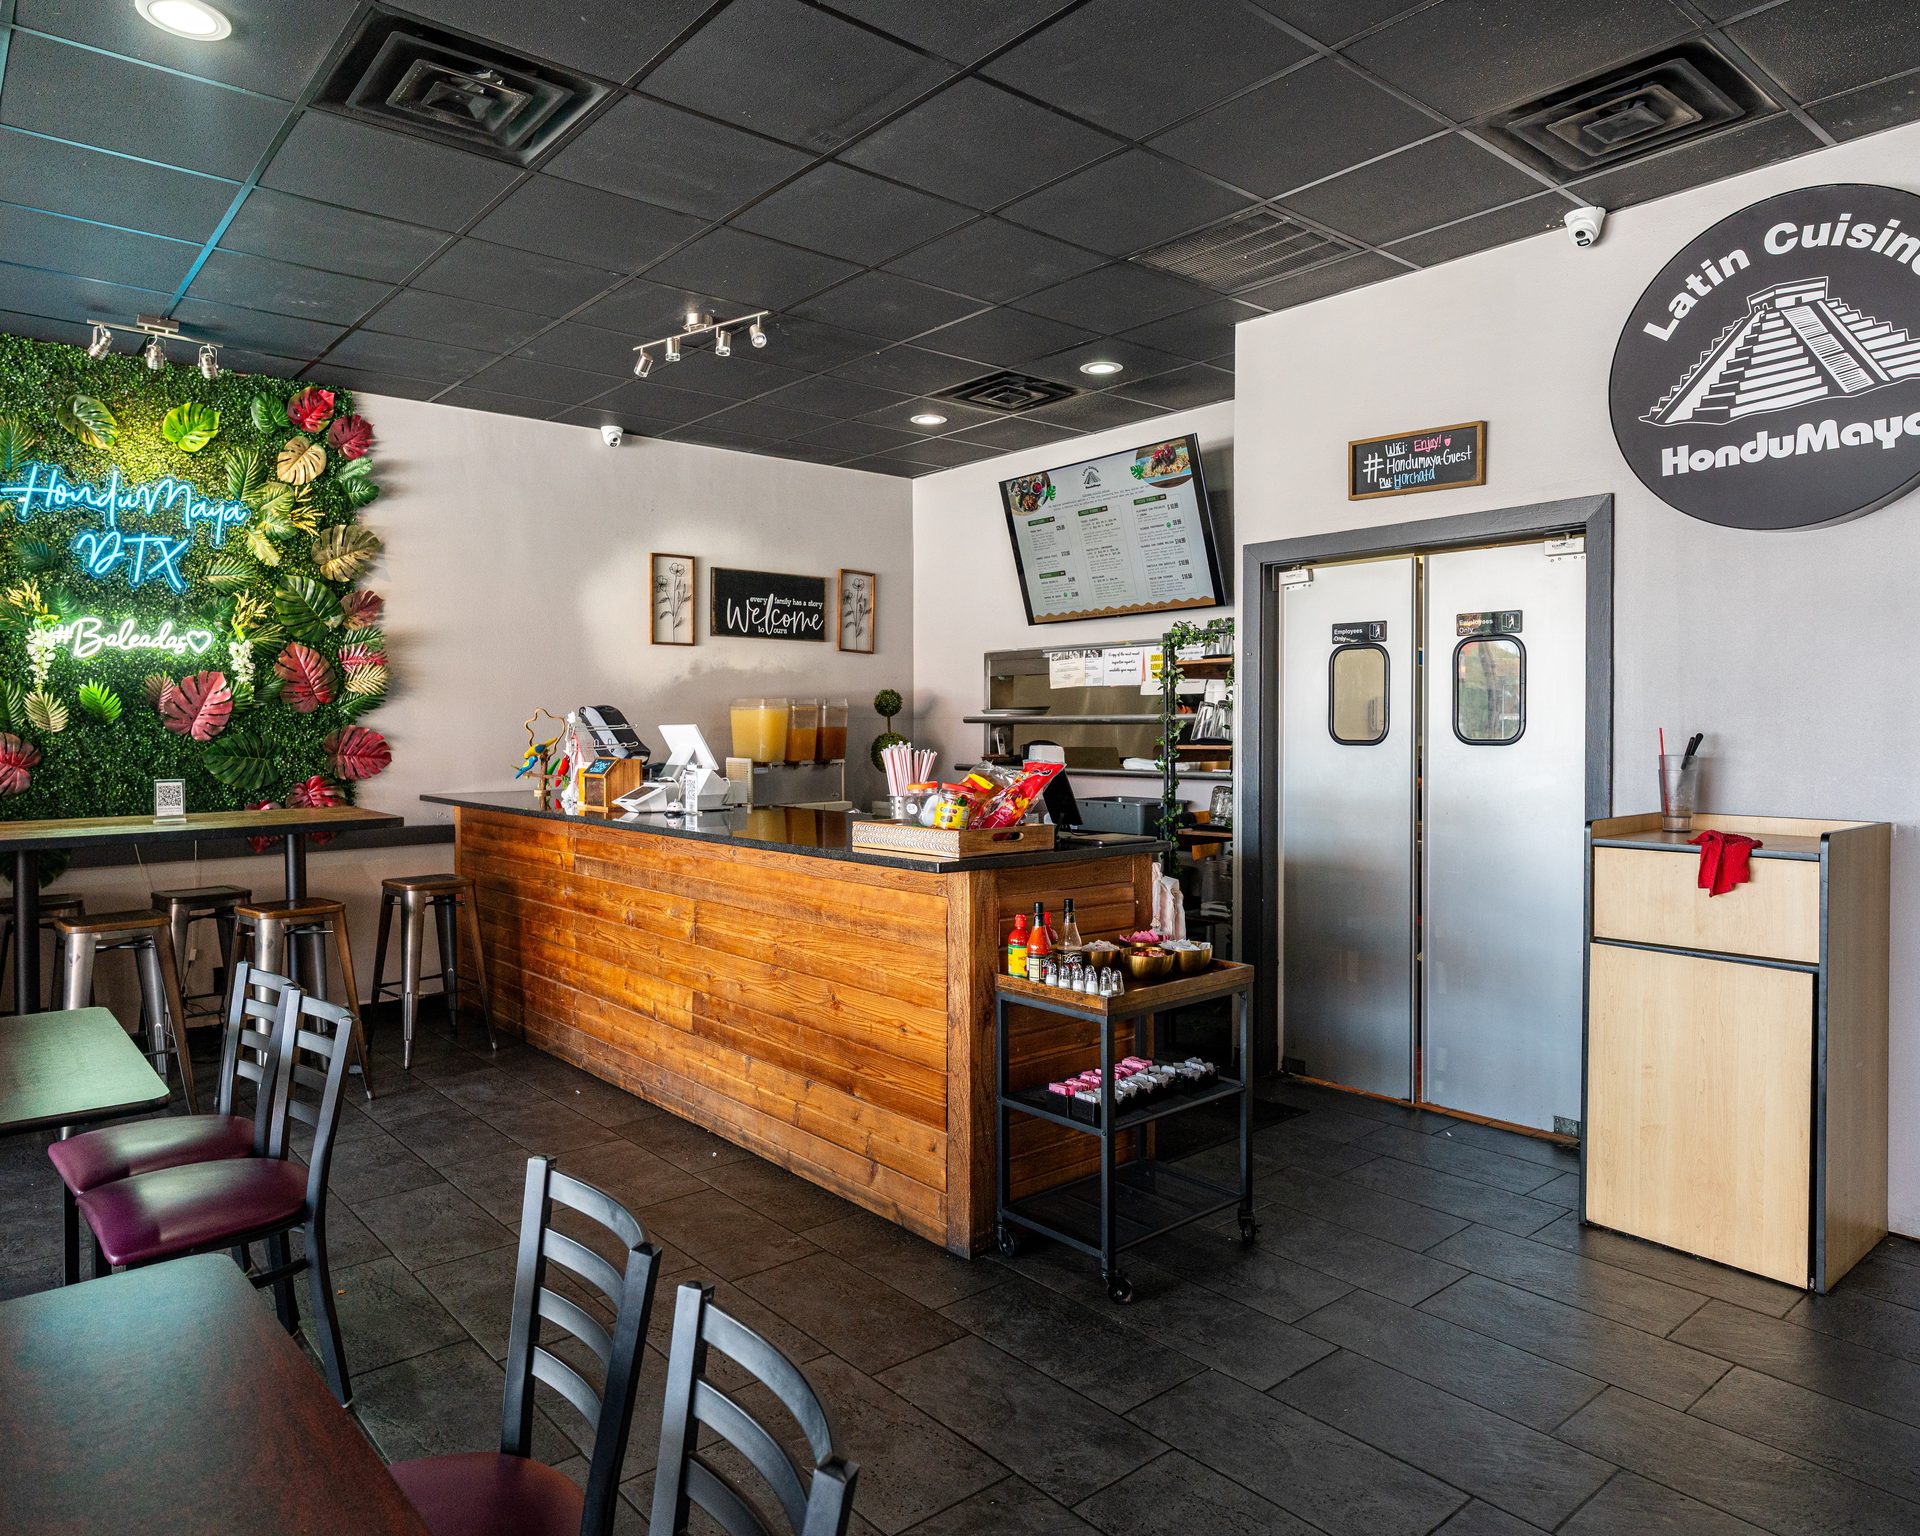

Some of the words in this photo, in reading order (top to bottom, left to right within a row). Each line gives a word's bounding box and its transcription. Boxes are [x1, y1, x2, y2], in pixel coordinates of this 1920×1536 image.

[1643, 248, 1750, 342] Latin
[1413, 434, 1442, 453] Enjoy!
[1393, 467, 1436, 489] Horchata
[1, 465, 247, 545] HonduMaya
[76, 531, 189, 591] DTX
[749, 596, 768, 606] every
[774, 597, 792, 607] family
[808, 600, 824, 610] story
[726, 593, 824, 636] Welcome
[1459, 619, 1493, 627] Employees
[758, 625, 765, 633] to
[1333, 628, 1363, 636] Employees
[1333, 635, 1347, 643] Only
